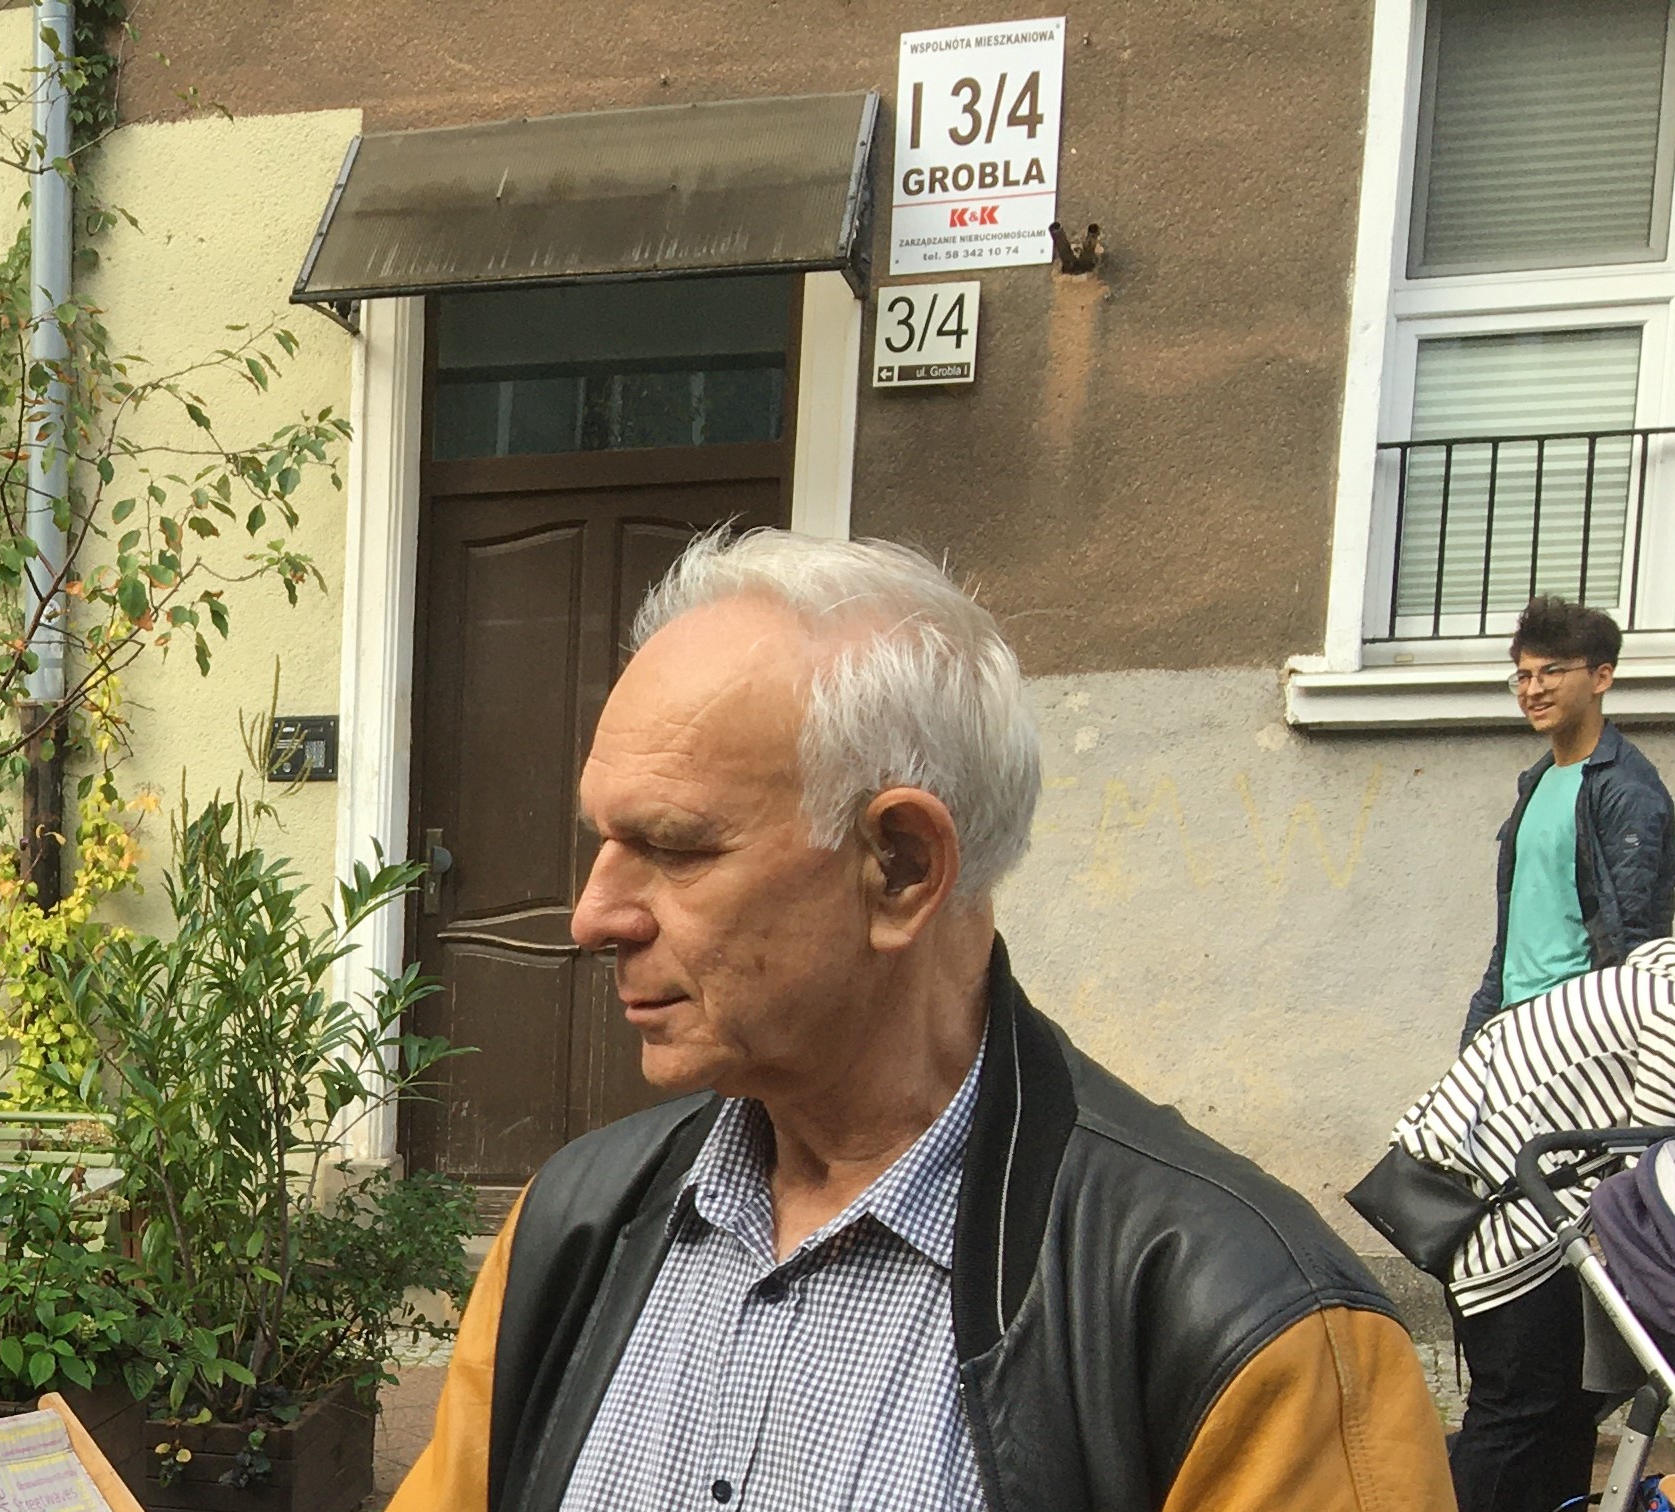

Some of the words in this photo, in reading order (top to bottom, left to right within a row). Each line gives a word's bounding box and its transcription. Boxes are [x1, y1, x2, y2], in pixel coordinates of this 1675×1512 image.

[975, 30, 1055, 48] MIESZKANIOWA
[948, 70, 1044, 147] 3/4
[902, 157, 1046, 196] GROBLA
[949, 205, 1000, 228] K&K
[899, 235, 957, 248] ZARZĄDZANIE
[959, 229, 1046, 243] NIERUCHOMOŚCIAMI
[923, 251, 941, 261] tel.
[945, 249, 959, 259] 58
[962, 248, 984, 258] 342
[988, 247, 1002, 256] 10
[1005, 246, 1019, 255] 74
[884, 292, 969, 353] 3/4
[915, 368, 927, 378] ul.
[929, 364, 962, 376] Grobla
